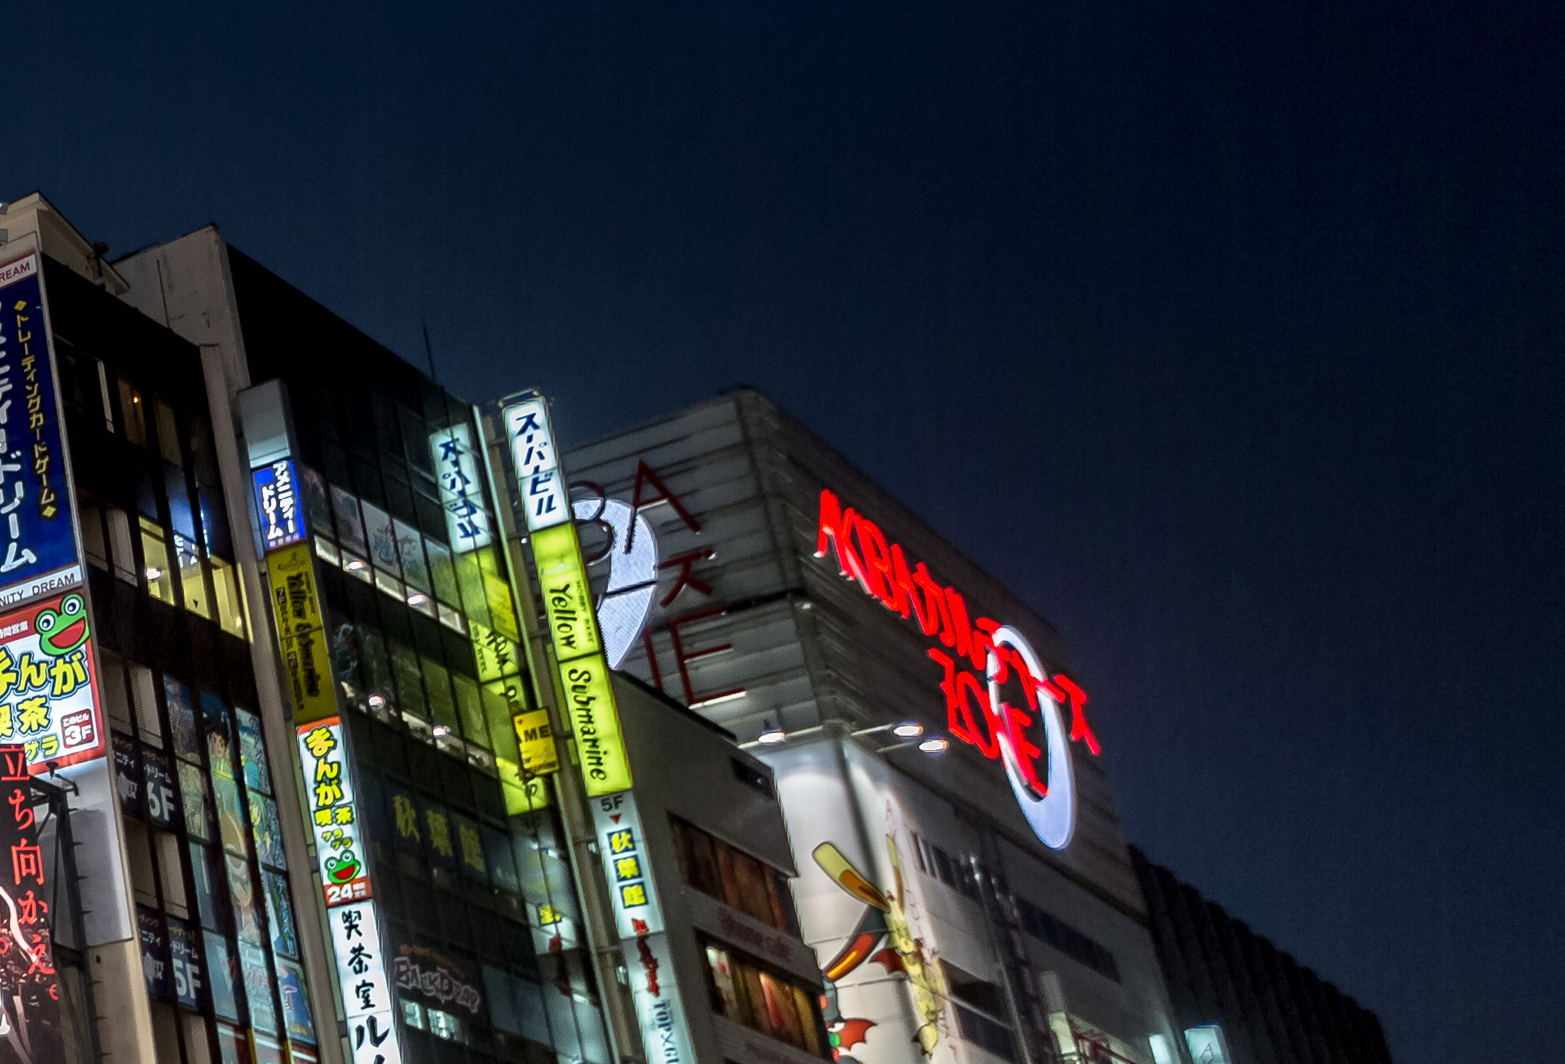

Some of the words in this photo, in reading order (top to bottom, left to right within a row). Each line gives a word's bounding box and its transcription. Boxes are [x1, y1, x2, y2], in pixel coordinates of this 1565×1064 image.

[515, 412, 557, 517] スーパービル
[32, 573, 75, 596] DREAM
[65, 724, 93, 744] 3F
[303, 727, 342, 808] まんが
[146, 782, 175, 823] 6F
[601, 795, 623, 812] 5F
[173, 959, 201, 998] 5F
